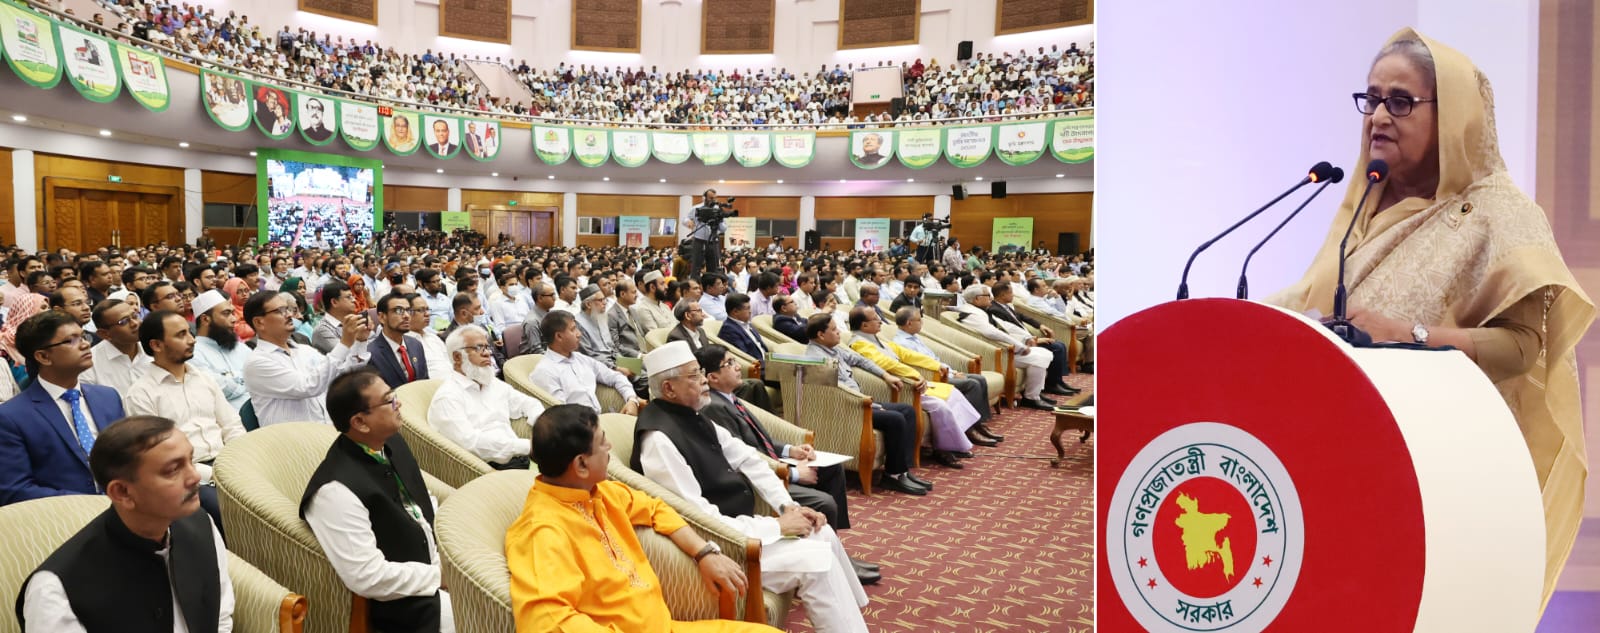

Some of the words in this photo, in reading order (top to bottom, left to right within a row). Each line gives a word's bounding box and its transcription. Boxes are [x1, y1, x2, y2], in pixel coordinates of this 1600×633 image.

[1131, 447, 1205, 538] গণপ্রজাতন্ত্রী
[1219, 455, 1279, 534] বাংলাদেশ
[1176, 599, 1234, 623] সরকার
